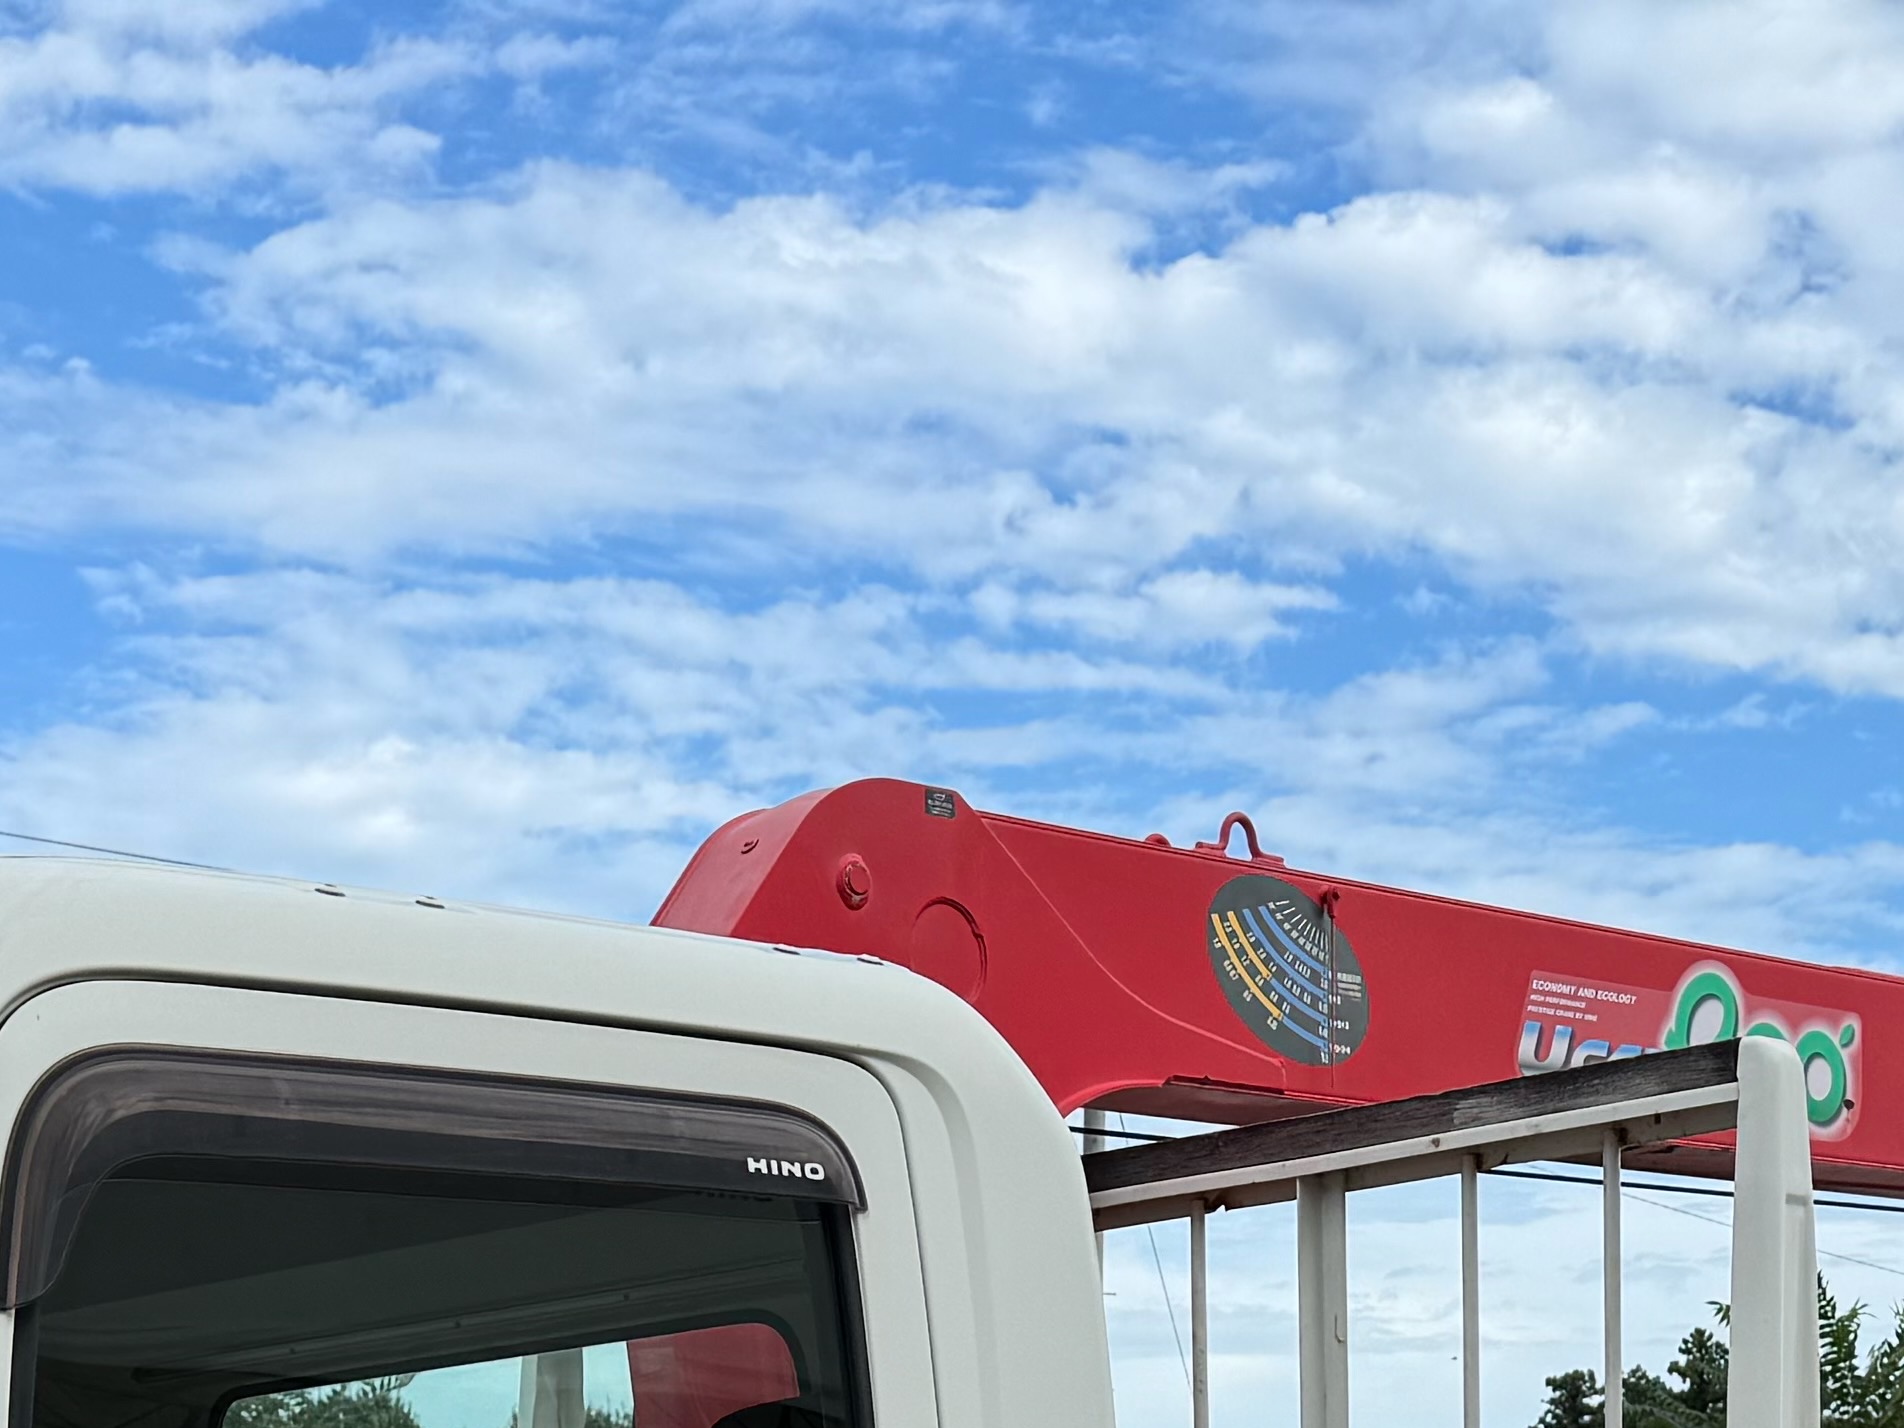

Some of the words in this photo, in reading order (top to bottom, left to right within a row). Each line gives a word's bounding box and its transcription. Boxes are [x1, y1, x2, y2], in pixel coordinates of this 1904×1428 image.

[1532, 979, 1577, 996] ECONOMY
[1577, 987, 1596, 998] AND
[1596, 990, 1637, 1005] ECOLOGY
[746, 1156, 825, 1181] HINO
